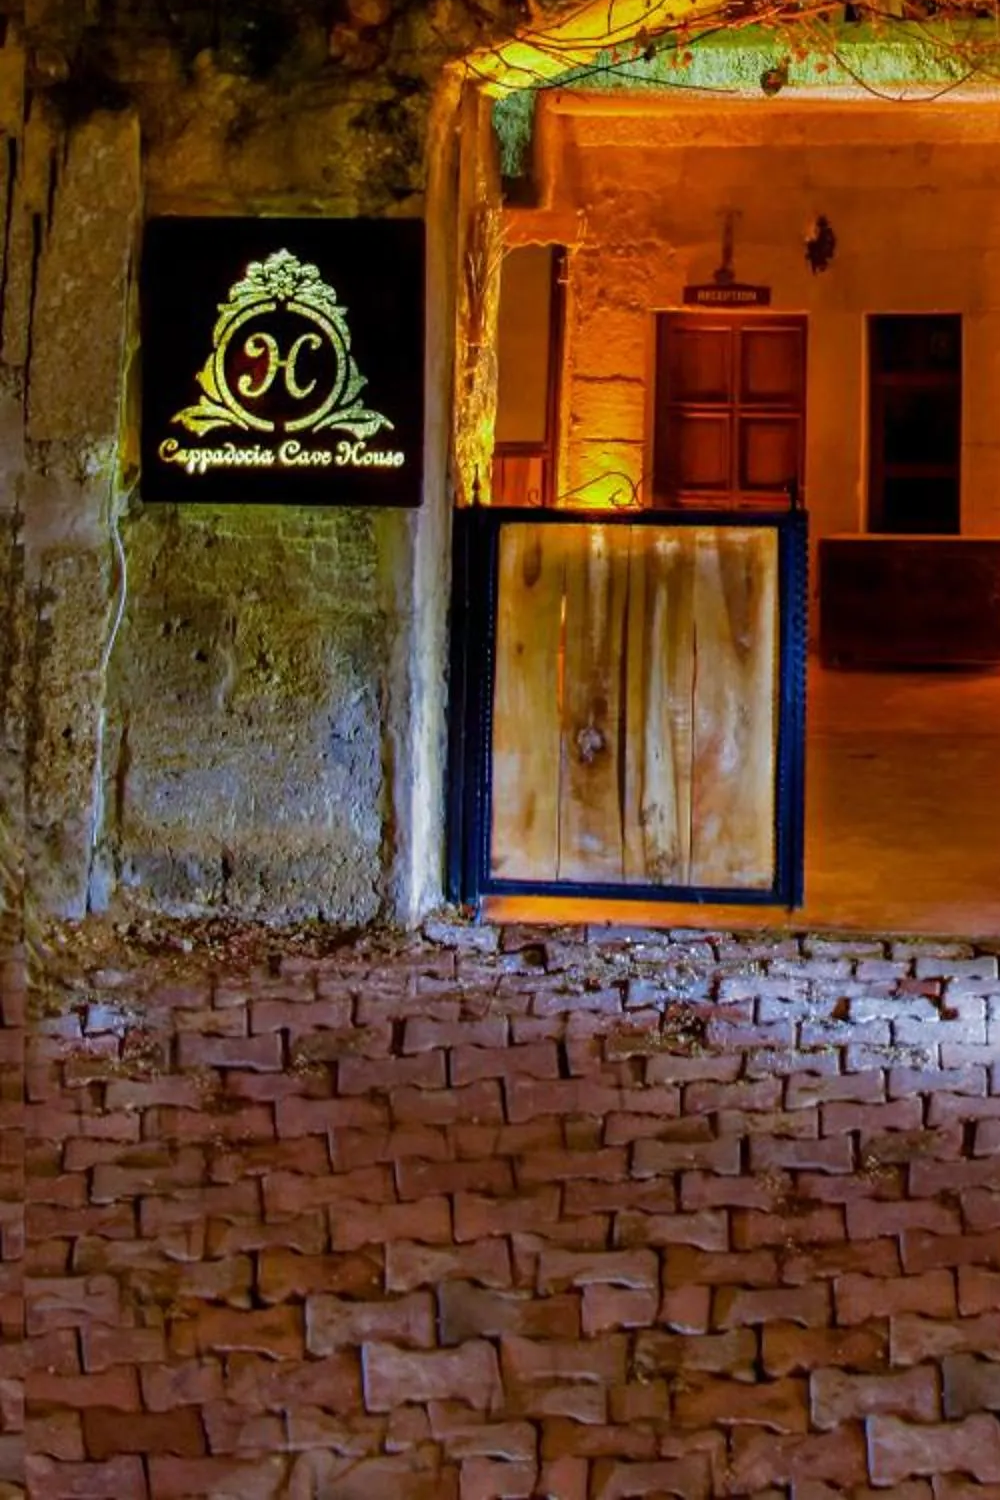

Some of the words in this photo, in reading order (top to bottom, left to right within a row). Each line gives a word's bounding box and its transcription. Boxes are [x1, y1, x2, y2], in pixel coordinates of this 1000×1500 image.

[697, 289, 757, 302] RECEPTION
[159, 438, 275, 474] Cappadocia
[279, 440, 331, 467] Cave
[335, 441, 405, 467] House
